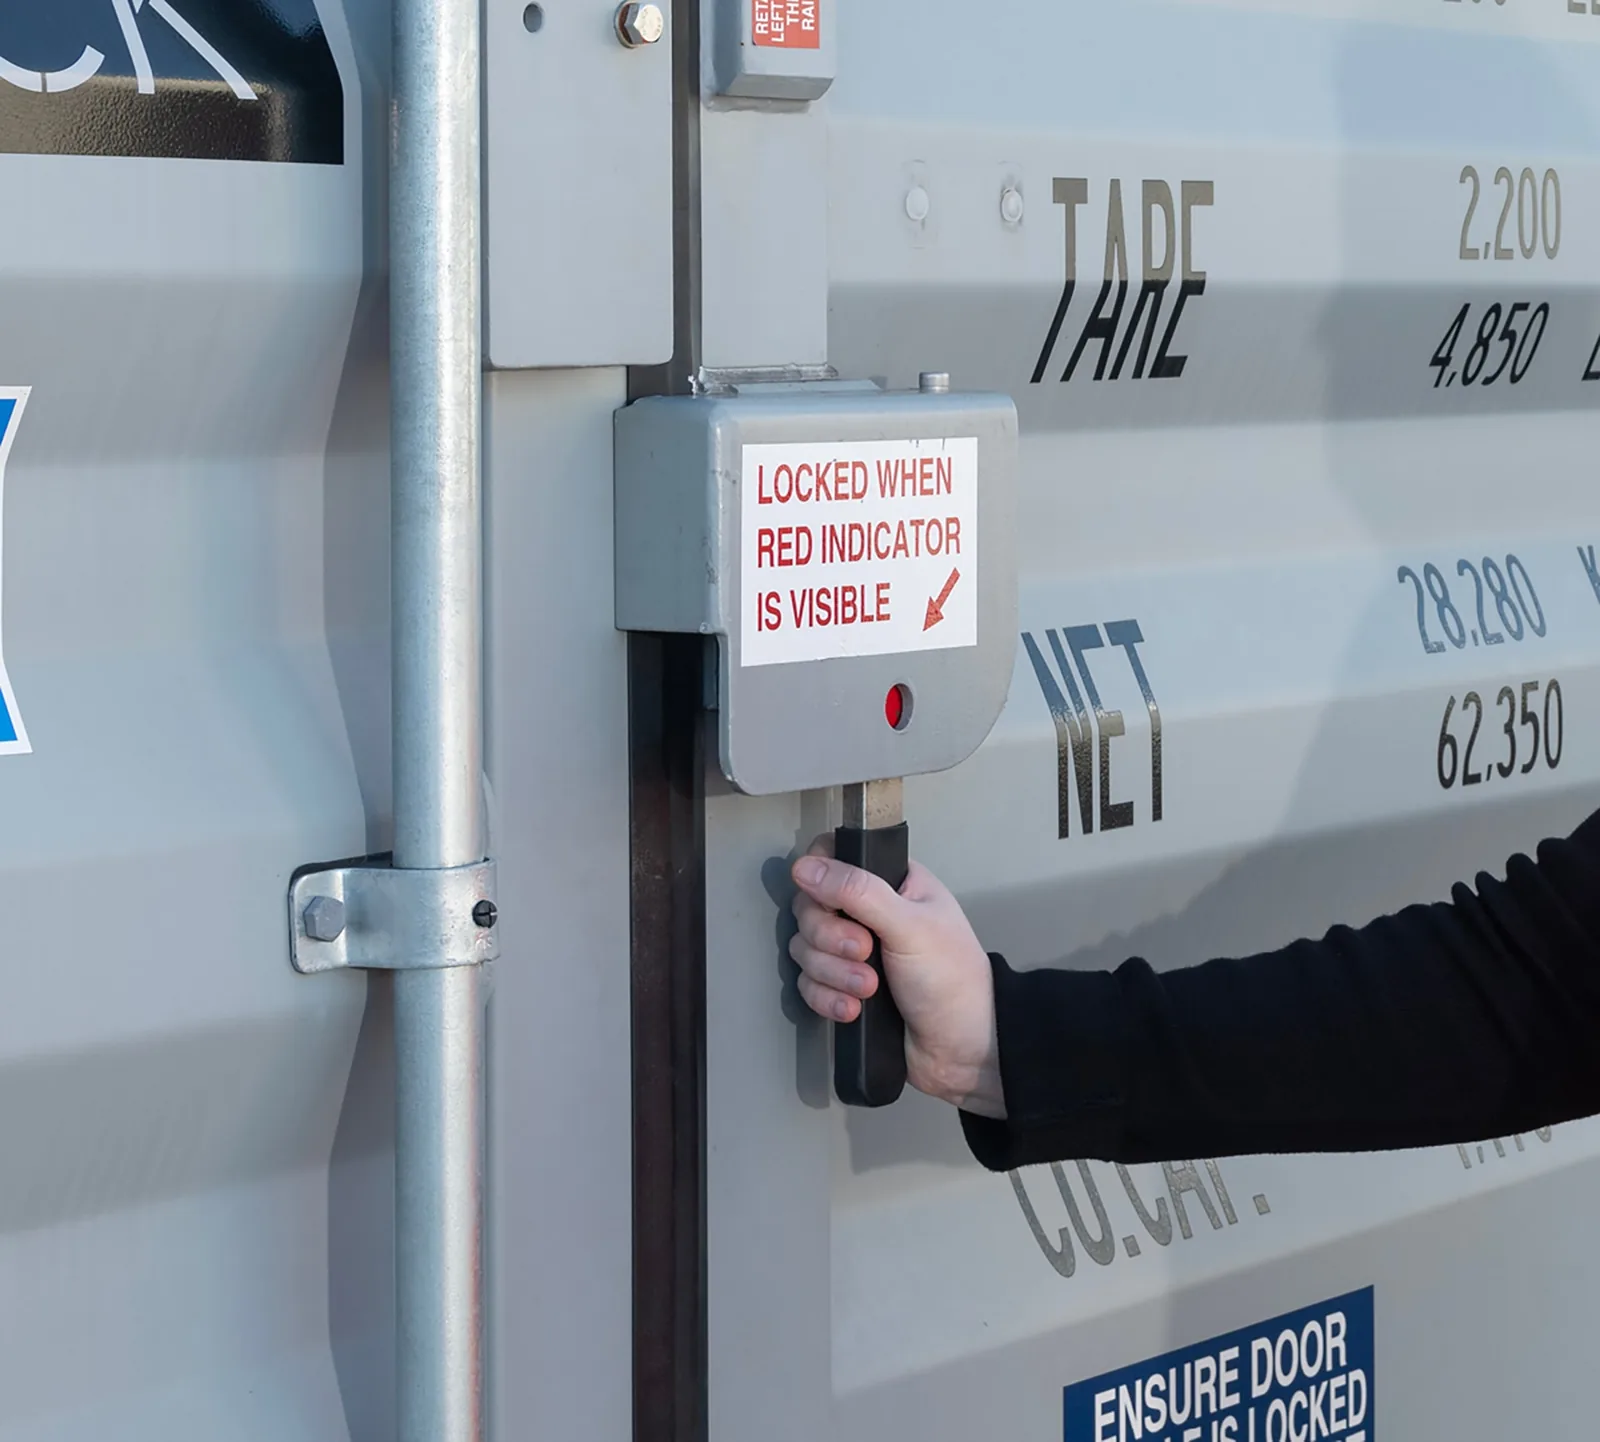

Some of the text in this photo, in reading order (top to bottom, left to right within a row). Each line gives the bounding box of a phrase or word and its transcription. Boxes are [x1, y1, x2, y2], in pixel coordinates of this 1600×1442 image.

[1459, 165, 1562, 260] 2,200
[1030, 177, 1214, 384] TARE
[1429, 302, 1550, 388] 4,850
[757, 456, 952, 505] LOCKED WHEN
[757, 516, 961, 568] RED INDICATOR
[757, 582, 891, 632] IS VISIBLE
[1020, 618, 1163, 840] NET
[1436, 678, 1564, 790] 62,350
[1094, 1311, 1347, 1442] ENSURE DOOR
[1249, 1368, 1367, 1442] LOCKED
